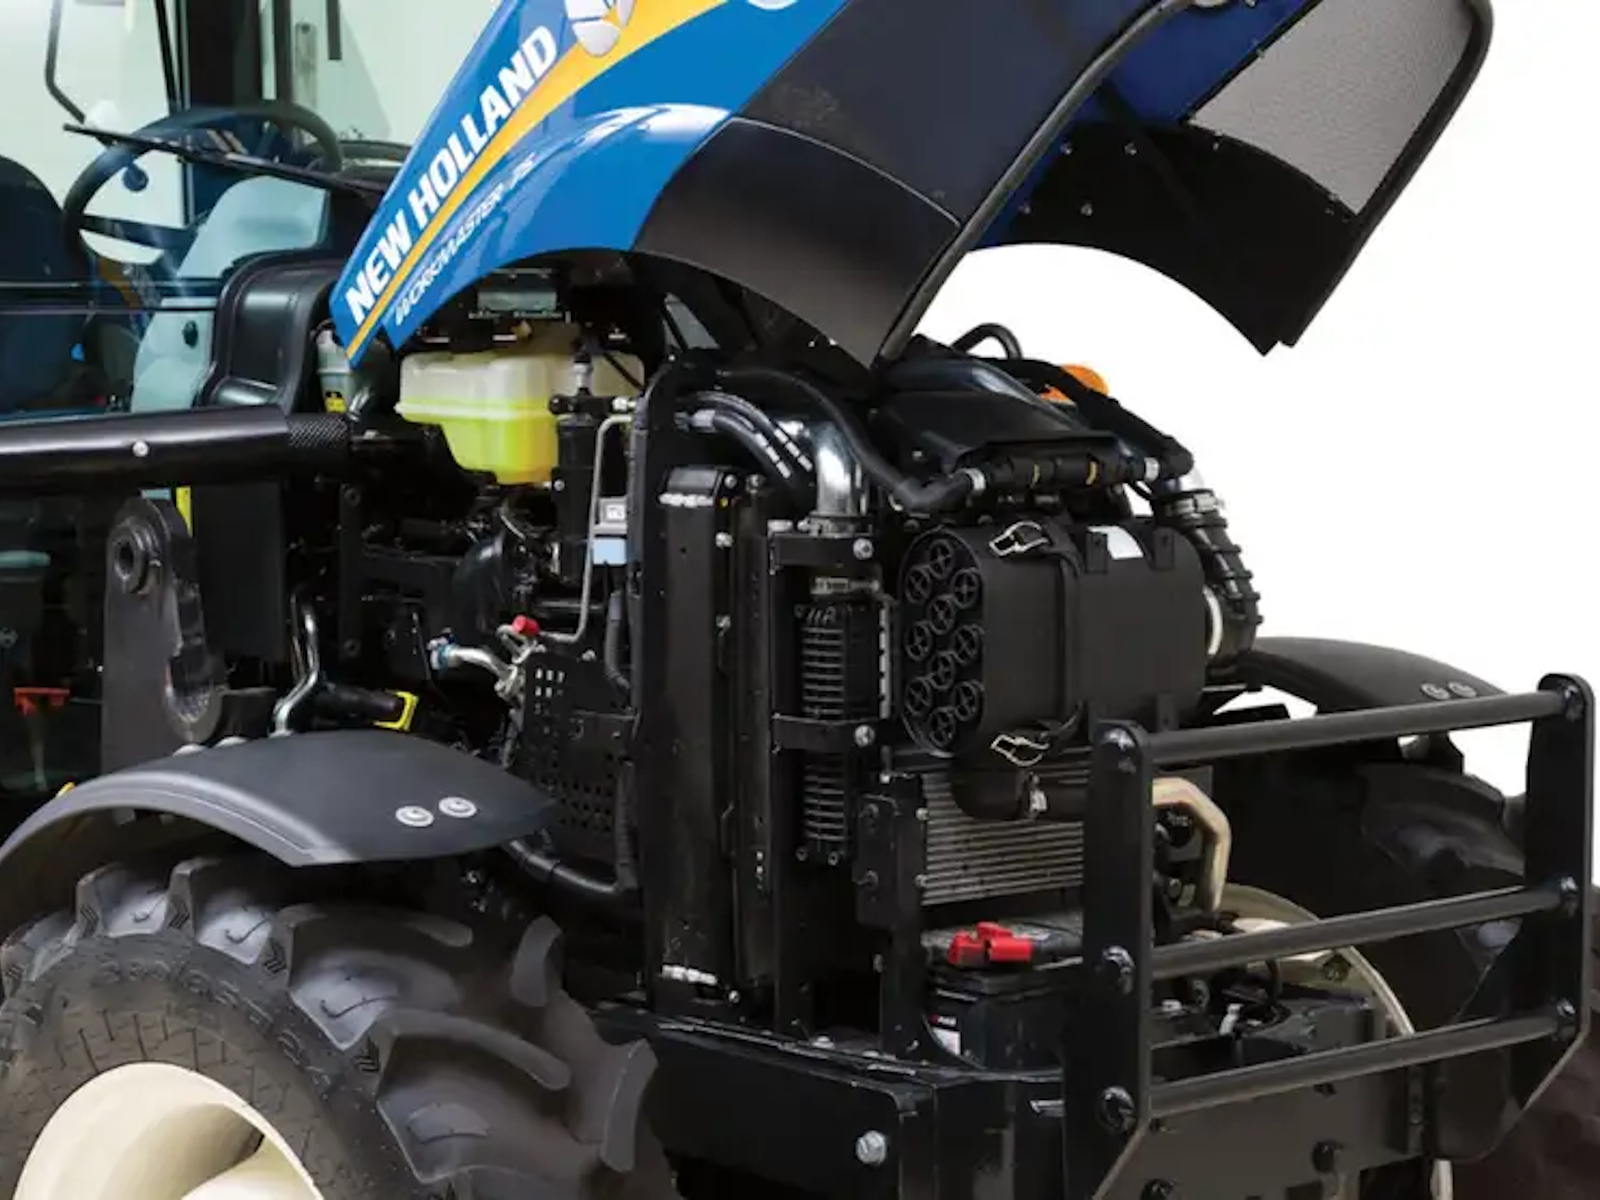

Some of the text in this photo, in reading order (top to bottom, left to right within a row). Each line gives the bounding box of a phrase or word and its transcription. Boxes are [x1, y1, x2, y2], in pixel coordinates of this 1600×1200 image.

[345, 26, 558, 326] NEW HOLLAND
[395, 181, 503, 326] WORKMASTER
